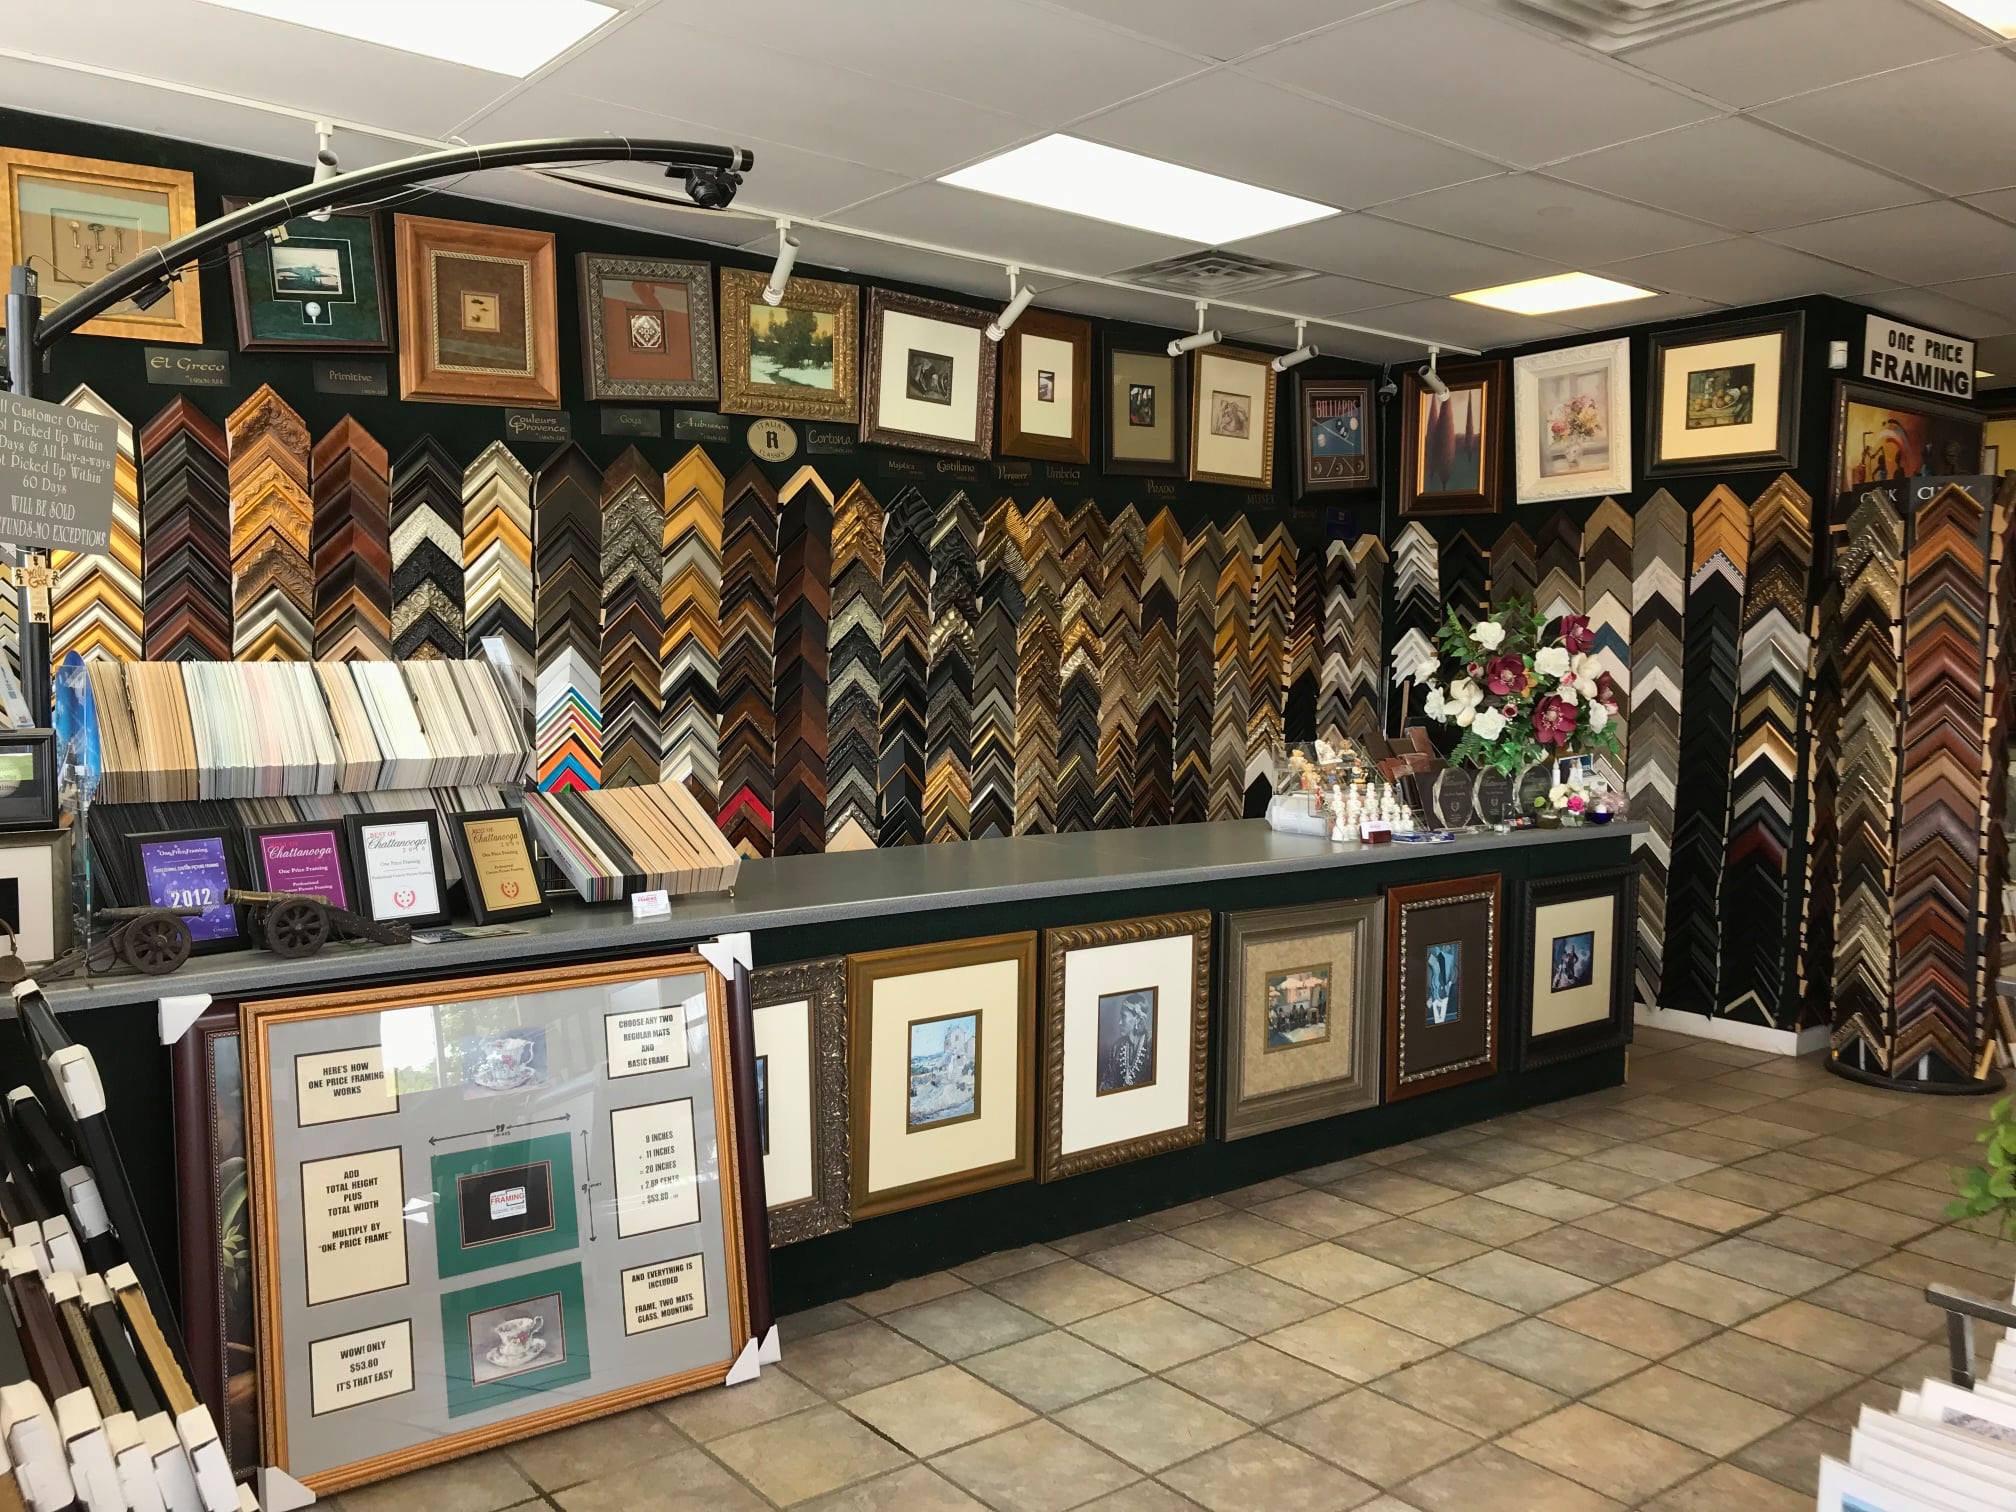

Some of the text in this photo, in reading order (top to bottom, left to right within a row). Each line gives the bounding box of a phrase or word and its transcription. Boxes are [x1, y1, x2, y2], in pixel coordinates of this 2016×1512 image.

[1888, 329, 1963, 364] ONE PRICE
[176, 357, 225, 372] Greco
[328, 370, 374, 382] Primitive
[1870, 350, 1969, 395] FRAMING
[1315, 400, 1359, 417] BILLIARDS
[12, 402, 63, 425] Customer
[66, 415, 99, 434] Order
[508, 413, 557, 428] Couleurs
[619, 414, 641, 427] Goya
[13, 419, 51, 440] Picked
[55, 430, 68, 447] Up
[73, 433, 103, 452] Within
[514, 422, 568, 435] Provence
[0, 434, 24, 454] Days
[42, 444, 57, 459] All
[766, 430, 779, 449] R
[11, 454, 49, 474] Picked
[53, 462, 66, 481] Up
[71, 466, 101, 484] Within
[22, 475, 67, 497] 60 Days
[11, 494, 76, 521] WILL BE SOLD
[367, 838, 427, 850] Chattanooga
[472, 831, 518, 843] Chattanooga
[267, 846, 333, 859] Chattanooga
[171, 887, 213, 908] 2012
[618, 1014, 674, 1028] CHOOSE ANY TWO
[623, 1028, 671, 1041] REGULAR MATS
[641, 1043, 655, 1053] AND
[322, 1062, 369, 1076] HERE'S HOW
[627, 1055, 670, 1068] BASIC FRAME
[308, 1071, 385, 1090] ONE PRICE FRAMING
[333, 1085, 362, 1097] WORKS
[651, 1130, 674, 1143] INCHES
[653, 1145, 675, 1157] INCHES
[343, 1169, 360, 1180] ADD
[645, 1164, 654, 1174] 20
[655, 1160, 677, 1172] INCHES
[325, 1177, 378, 1194] TOTAL HEIGHT
[343, 1191, 363, 1202] PLUS
[490, 1193, 525, 1205] FRAMING
[327, 1200, 379, 1217] TOTAL WIDTH
[332, 1221, 381, 1240] MULTIPLY BY
[339, 1237, 362, 1249] PRICE
[631, 1262, 693, 1283] AND EVERYTHING IS
[648, 1275, 679, 1289] INCLUDED
[659, 1297, 674, 1308] TWO
[661, 1303, 693, 1318] MOUNTING
[340, 1340, 386, 1359] WOW! ONLY
[349, 1357, 379, 1373] $53.80
[336, 1369, 393, 1392] IT'S THAT EASY
